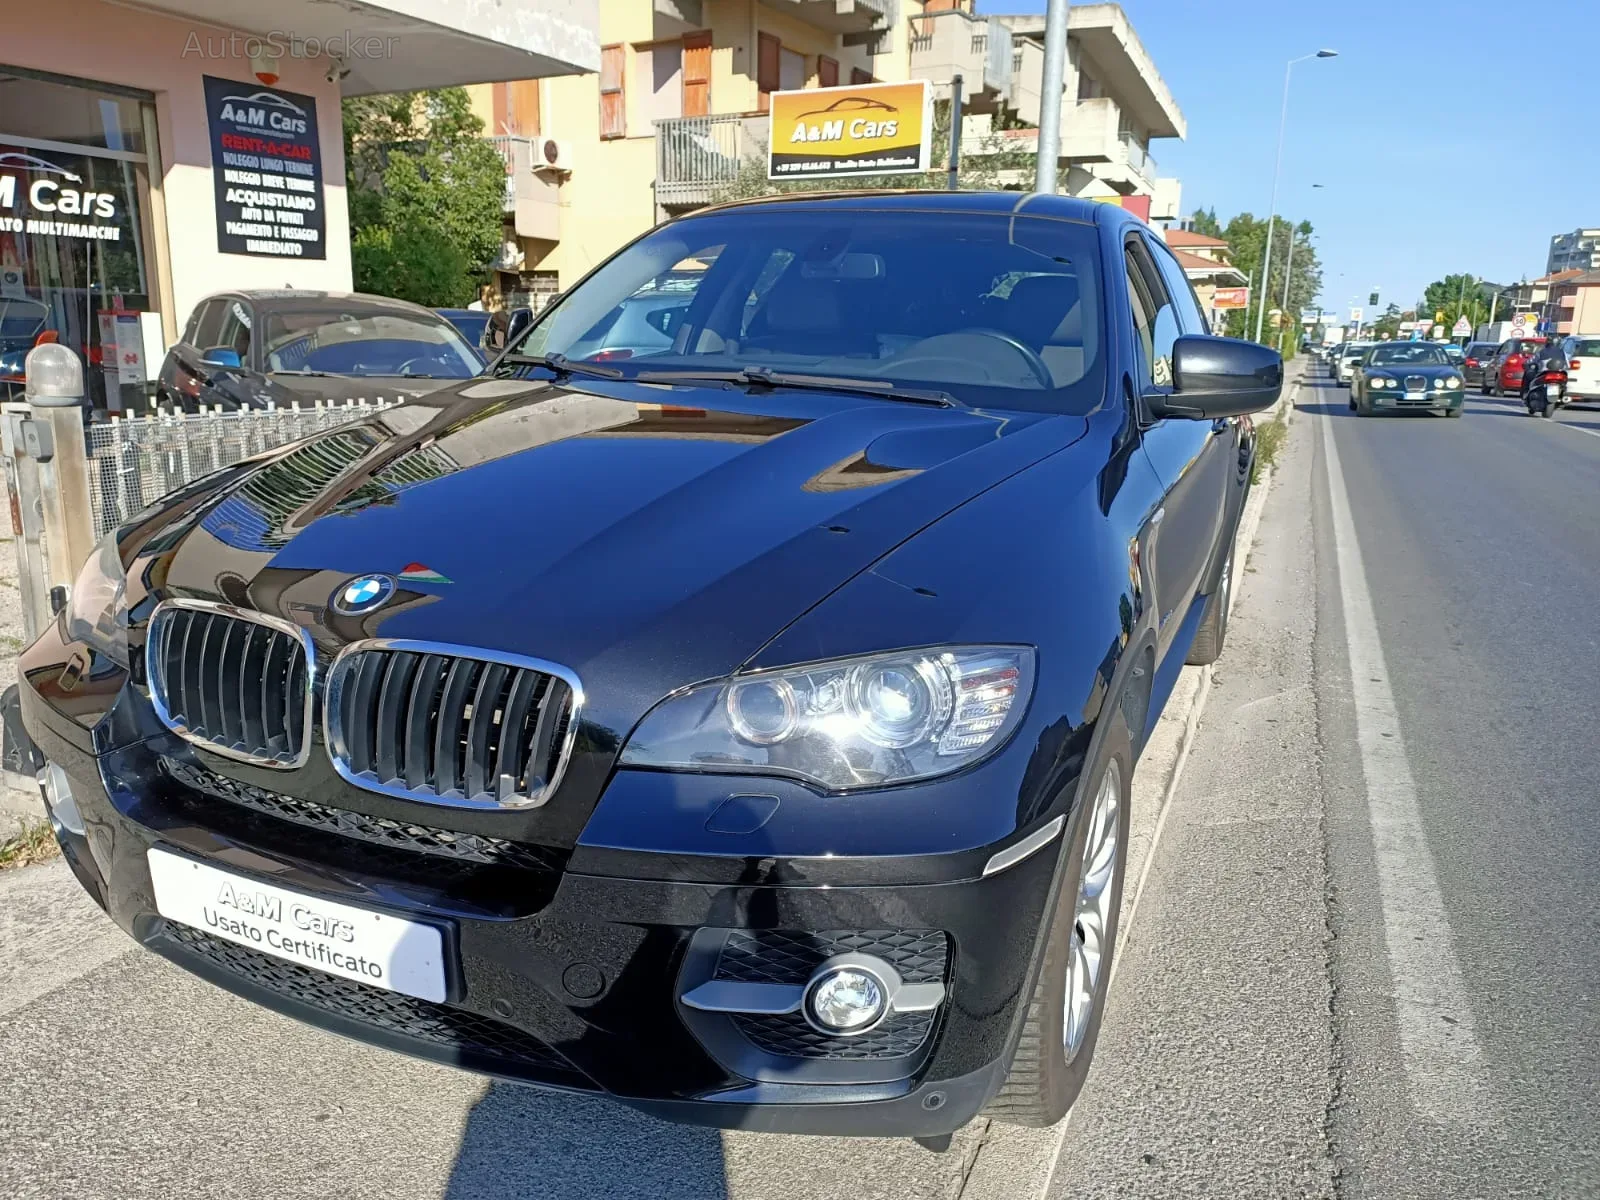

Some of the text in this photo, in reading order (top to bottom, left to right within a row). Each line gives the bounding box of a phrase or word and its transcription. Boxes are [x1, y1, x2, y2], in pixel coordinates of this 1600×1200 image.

[220, 103, 266, 127] A&M
[269, 111, 307, 133] Cars
[790, 118, 899, 143] A&M Cars
[222, 151, 259, 169] NOLEGGIO
[260, 157, 284, 172] LUNGO
[29, 179, 115, 218] Cars
[226, 188, 316, 211] ACQUISTIAMO
[241, 206, 263, 222] AUTO
[26, 220, 120, 241] MULTIMARCHE
[225, 221, 273, 238] PAGAMENTO
[246, 239, 303, 256] IMMEDIATO
[217, 880, 355, 943] A&M Cars
[203, 906, 383, 979] Usato Certificato
